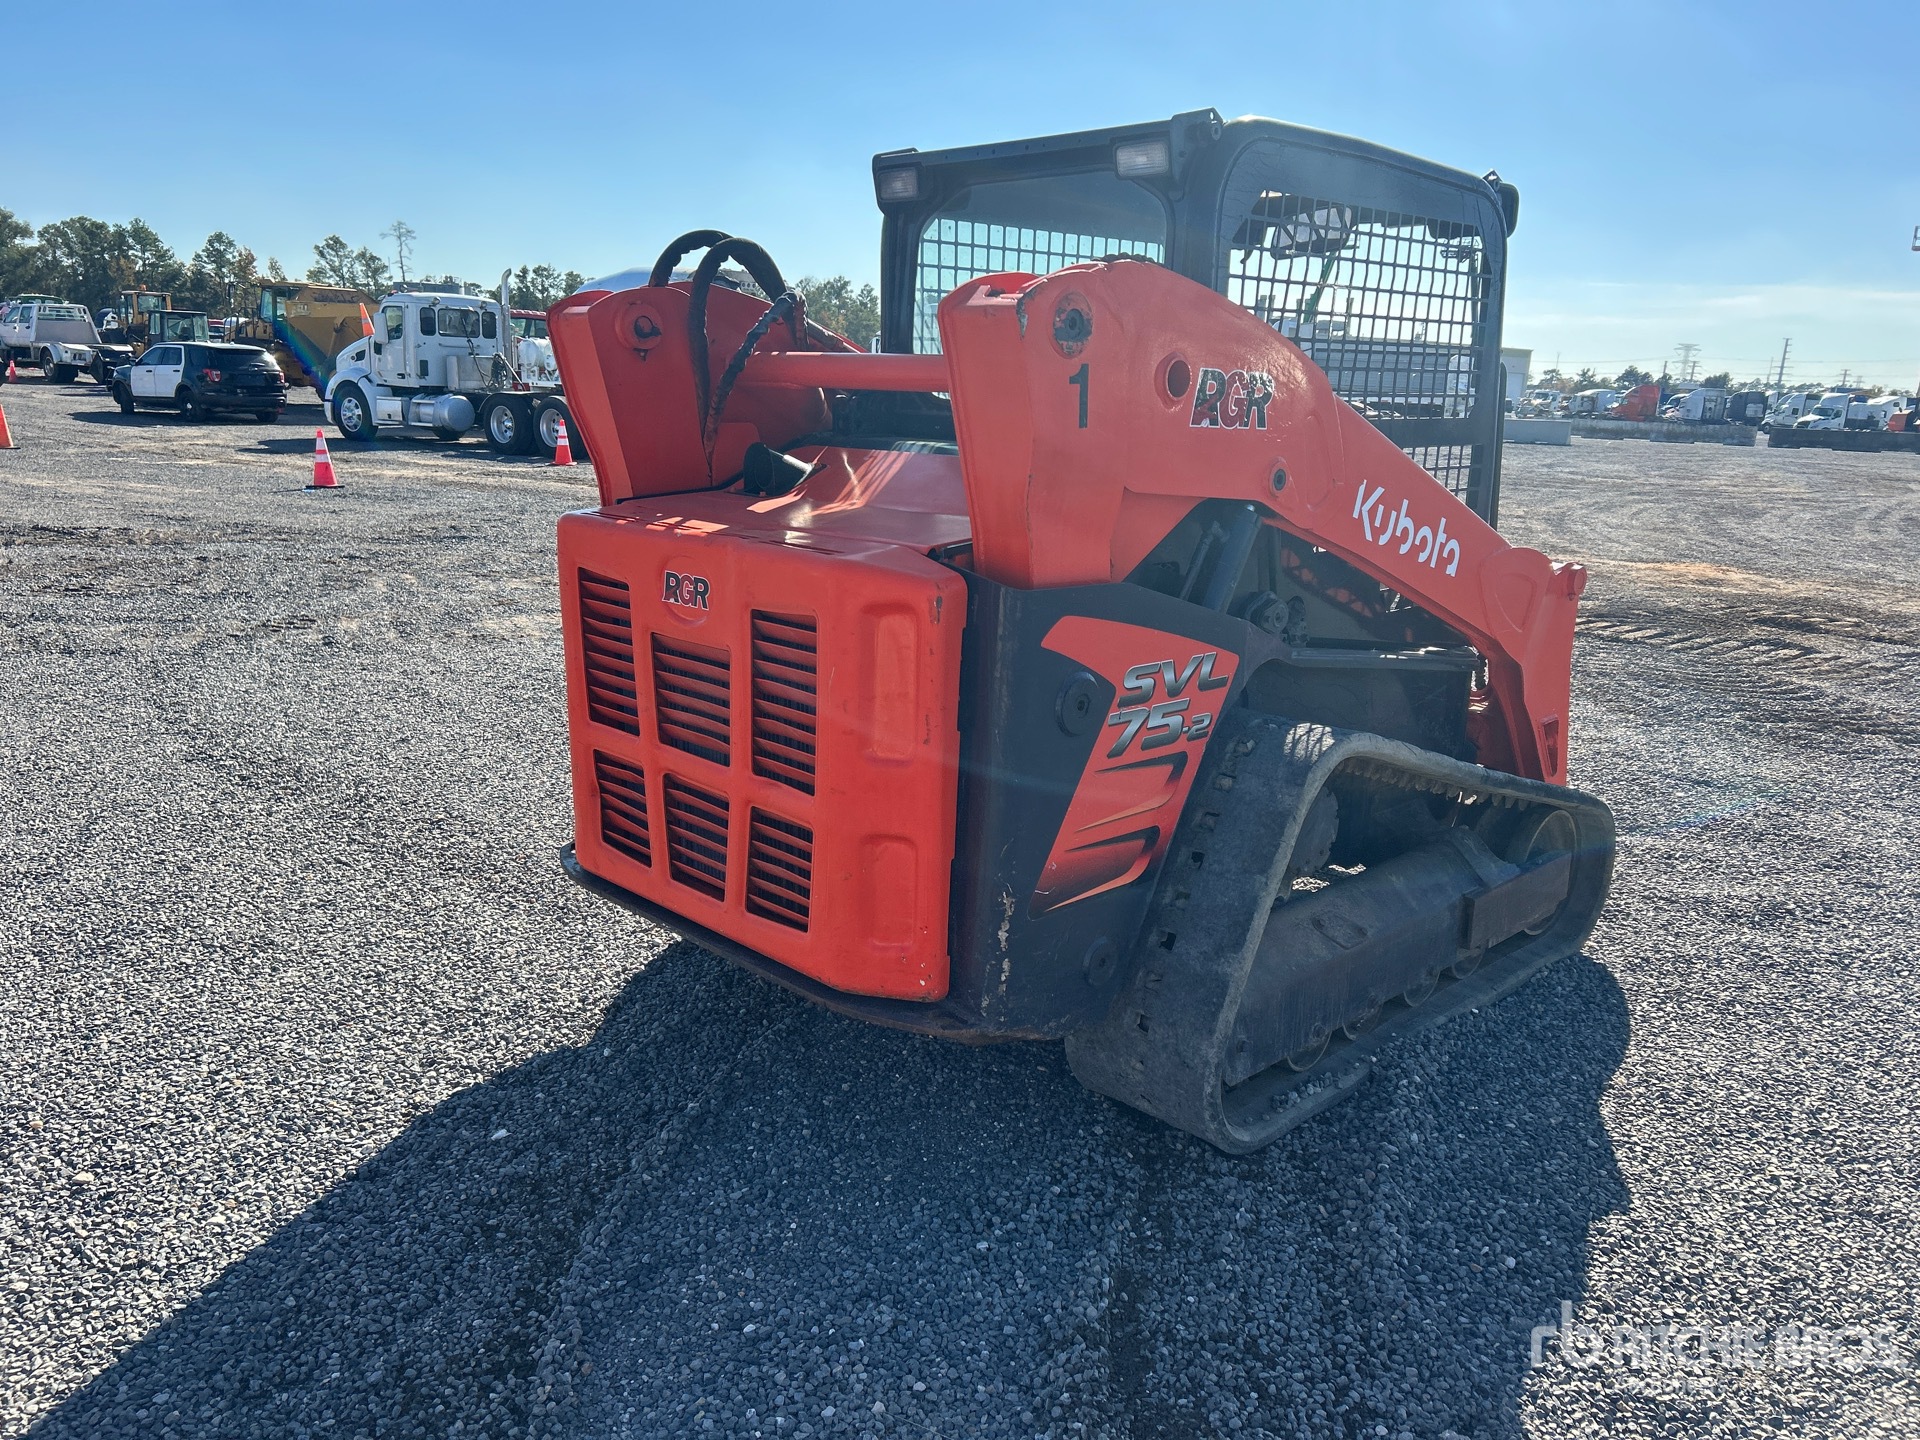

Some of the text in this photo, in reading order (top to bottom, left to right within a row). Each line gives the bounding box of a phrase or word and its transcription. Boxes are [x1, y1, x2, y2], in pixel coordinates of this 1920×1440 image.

[1068, 362, 1090, 429] 1
[1189, 367, 1275, 430] RGR
[1353, 479, 1461, 578] Kubota
[661, 570, 710, 611] RGR
[1117, 653, 1228, 706] SVL
[1107, 698, 1212, 758] 75-2
